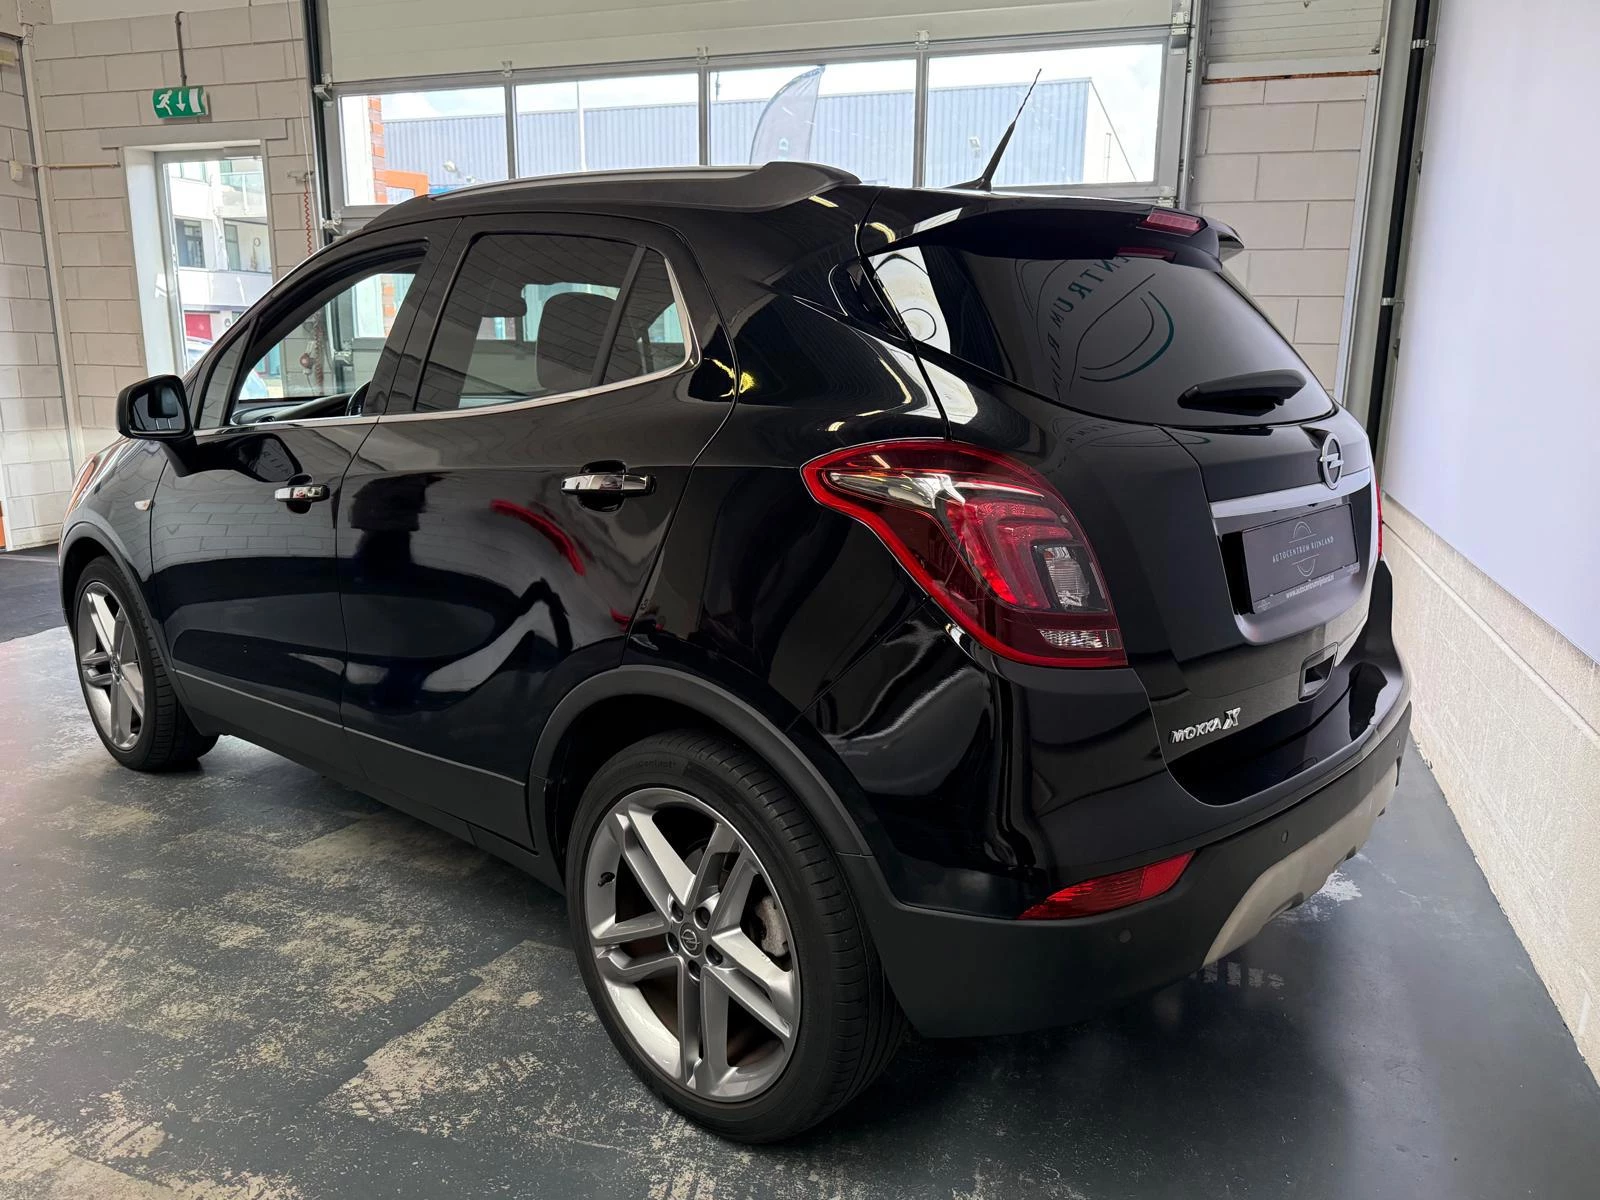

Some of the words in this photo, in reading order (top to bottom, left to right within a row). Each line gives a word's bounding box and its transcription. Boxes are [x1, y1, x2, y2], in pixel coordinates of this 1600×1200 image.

[1272, 545, 1310, 563] AUTOCENTRUM
[1311, 536, 1334, 549] RIJNLAND
[1170, 717, 1222, 744] MOKKA
[1222, 707, 1241, 730] X
